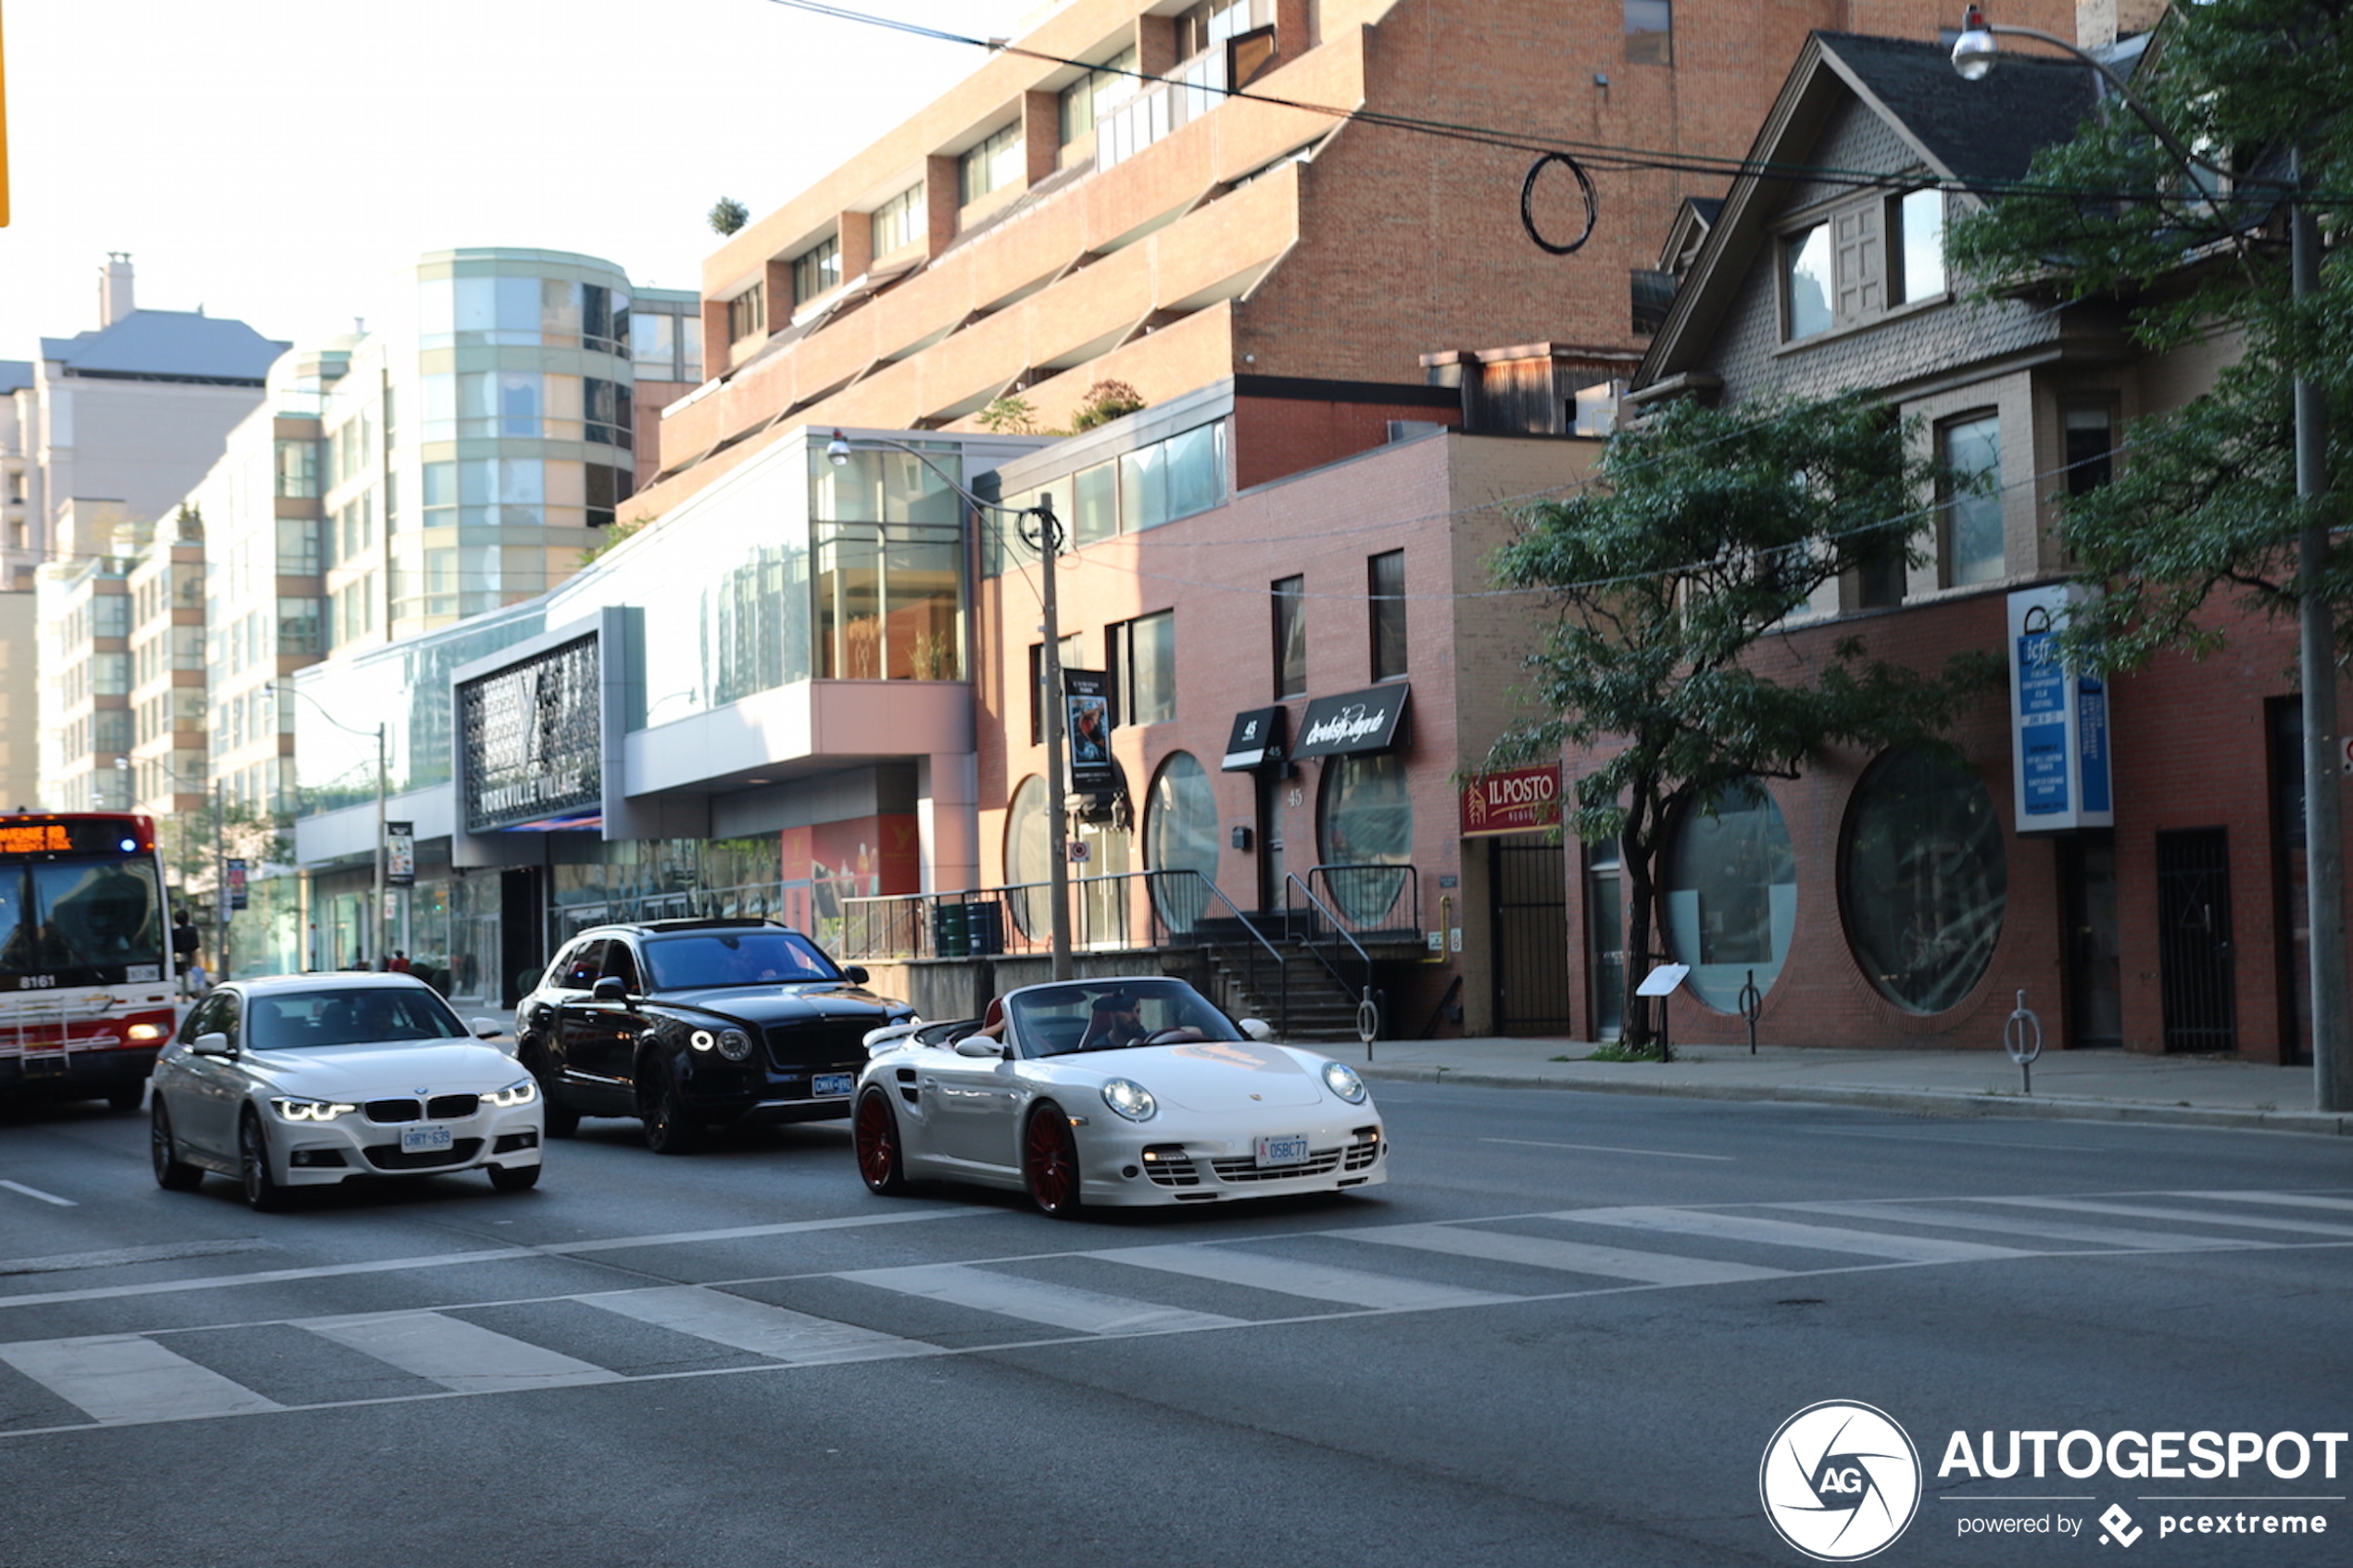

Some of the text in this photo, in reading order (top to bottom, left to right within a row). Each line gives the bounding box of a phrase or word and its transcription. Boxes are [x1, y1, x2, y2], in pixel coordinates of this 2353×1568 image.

[1267, 745, 1282, 757] 45
[480, 767, 583, 814] YORKVILLE VILLAGE
[1288, 788, 1302, 809] 45
[1489, 775, 1554, 806] IL POSTO
[19, 974, 56, 989] 8161
[405, 1130, 450, 1146] CHRY-639
[1270, 1140, 1307, 1158] 05BC77
